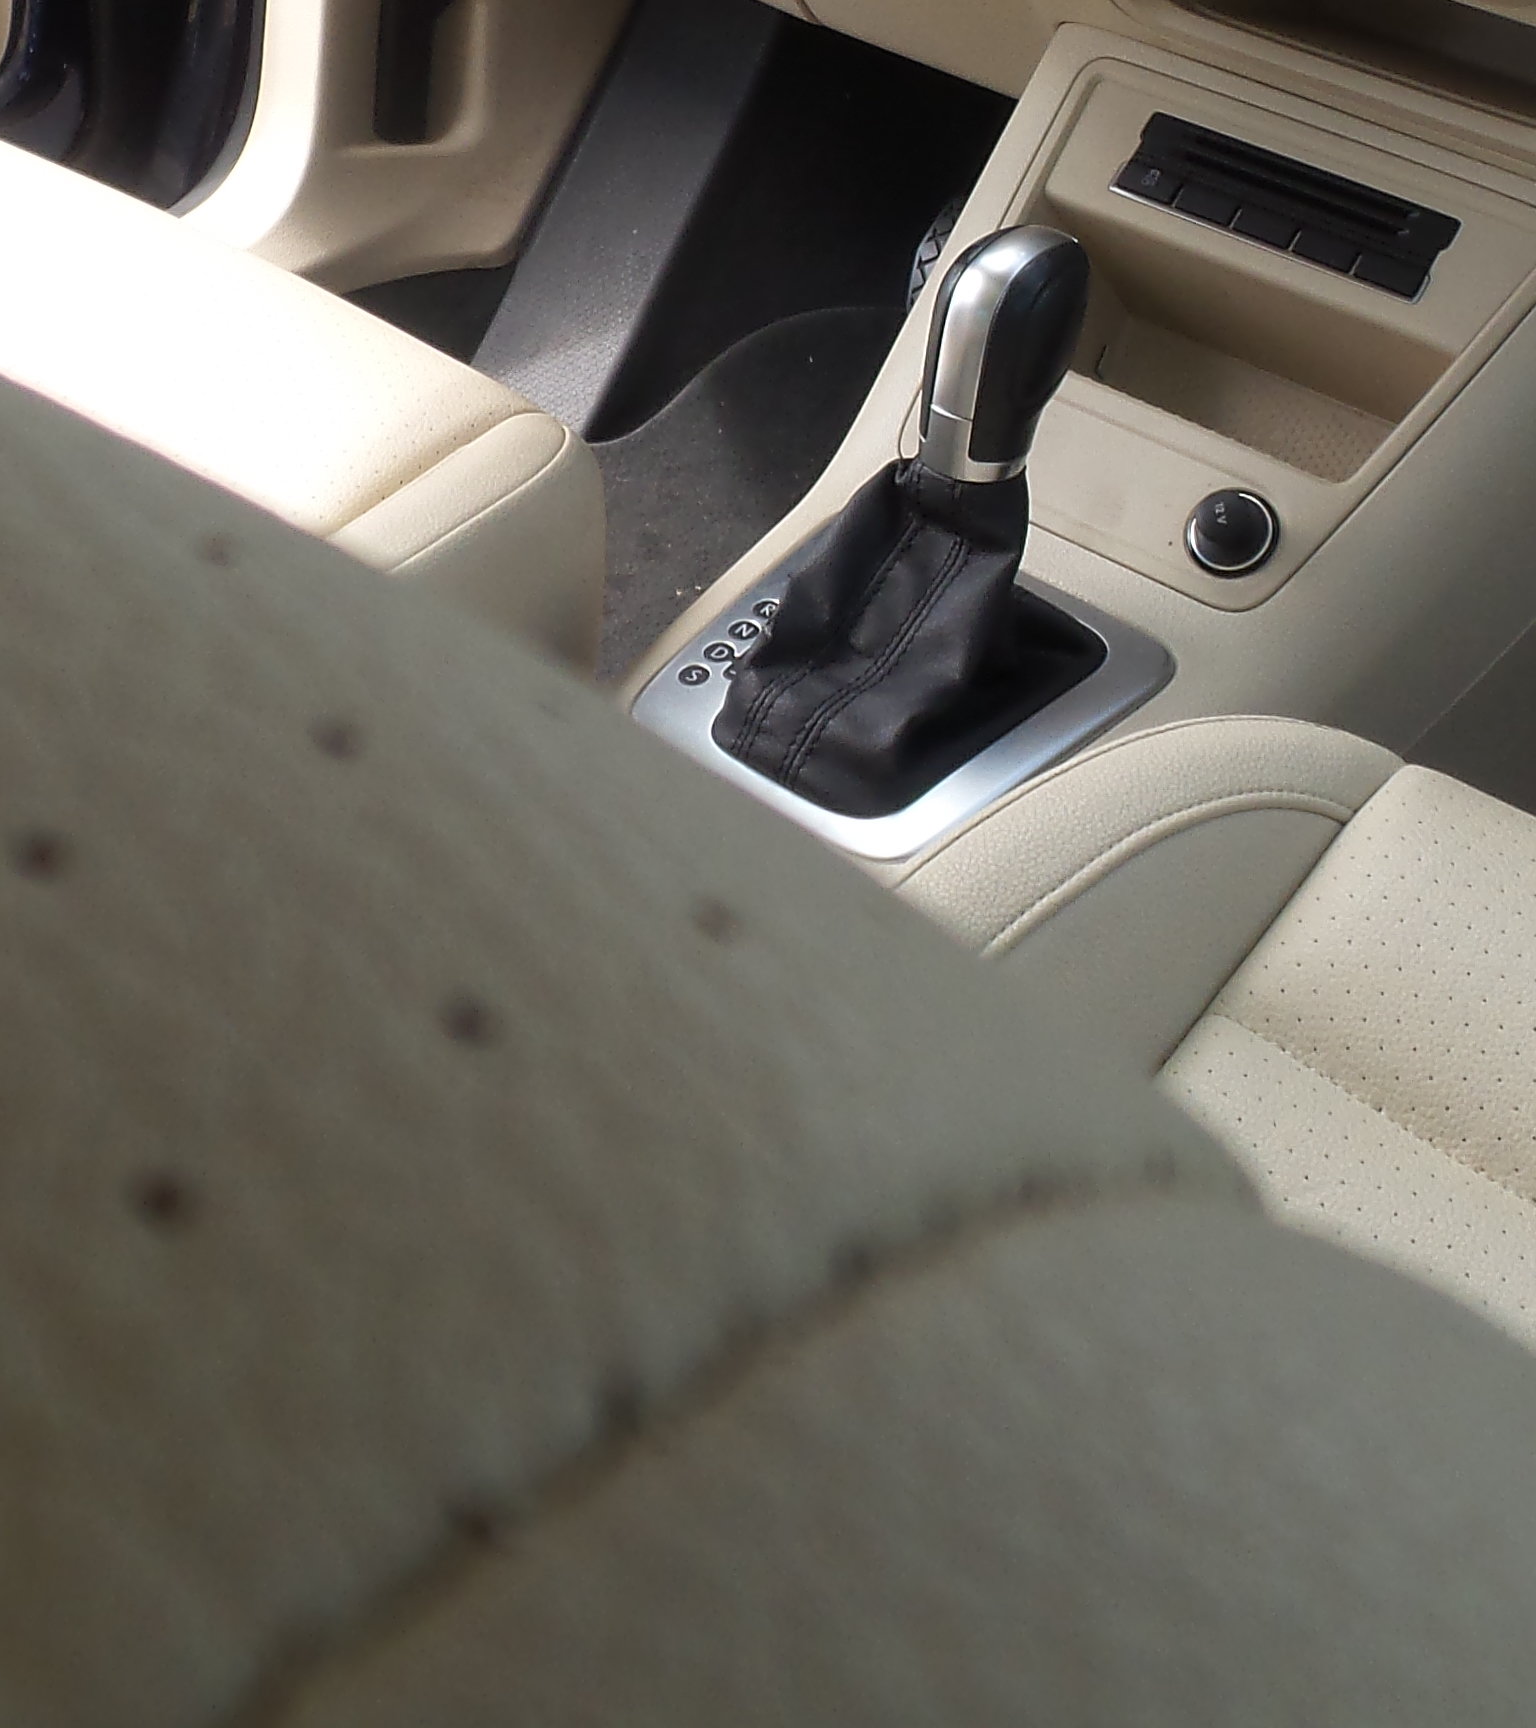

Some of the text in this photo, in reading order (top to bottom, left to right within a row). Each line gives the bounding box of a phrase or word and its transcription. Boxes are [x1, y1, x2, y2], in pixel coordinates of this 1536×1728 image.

[734, 624, 754, 637] N
[711, 647, 728, 658] D
[685, 670, 702, 681] S
